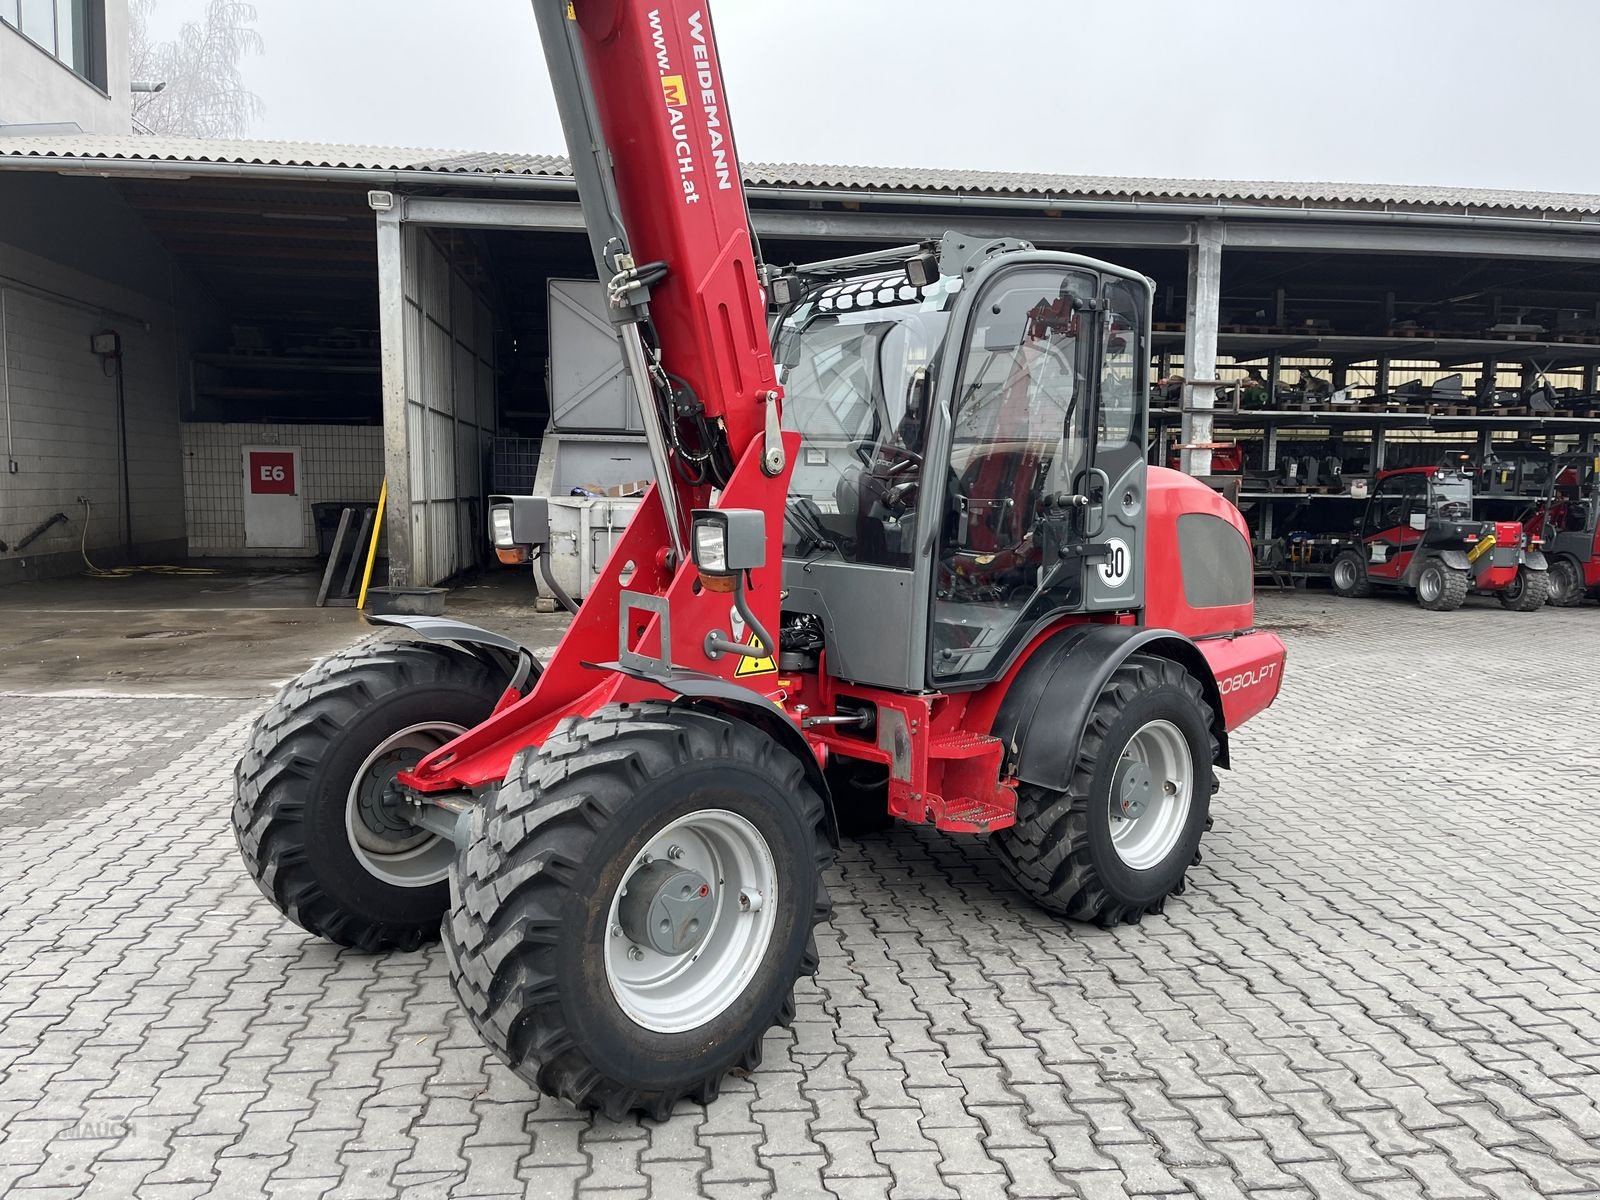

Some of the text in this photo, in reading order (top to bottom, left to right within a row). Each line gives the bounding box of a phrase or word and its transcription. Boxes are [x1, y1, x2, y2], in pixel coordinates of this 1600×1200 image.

[648, 9, 699, 204] www.MAUCH.at
[688, 10, 731, 190] WEIDEMANN
[260, 466, 285, 481] E6
